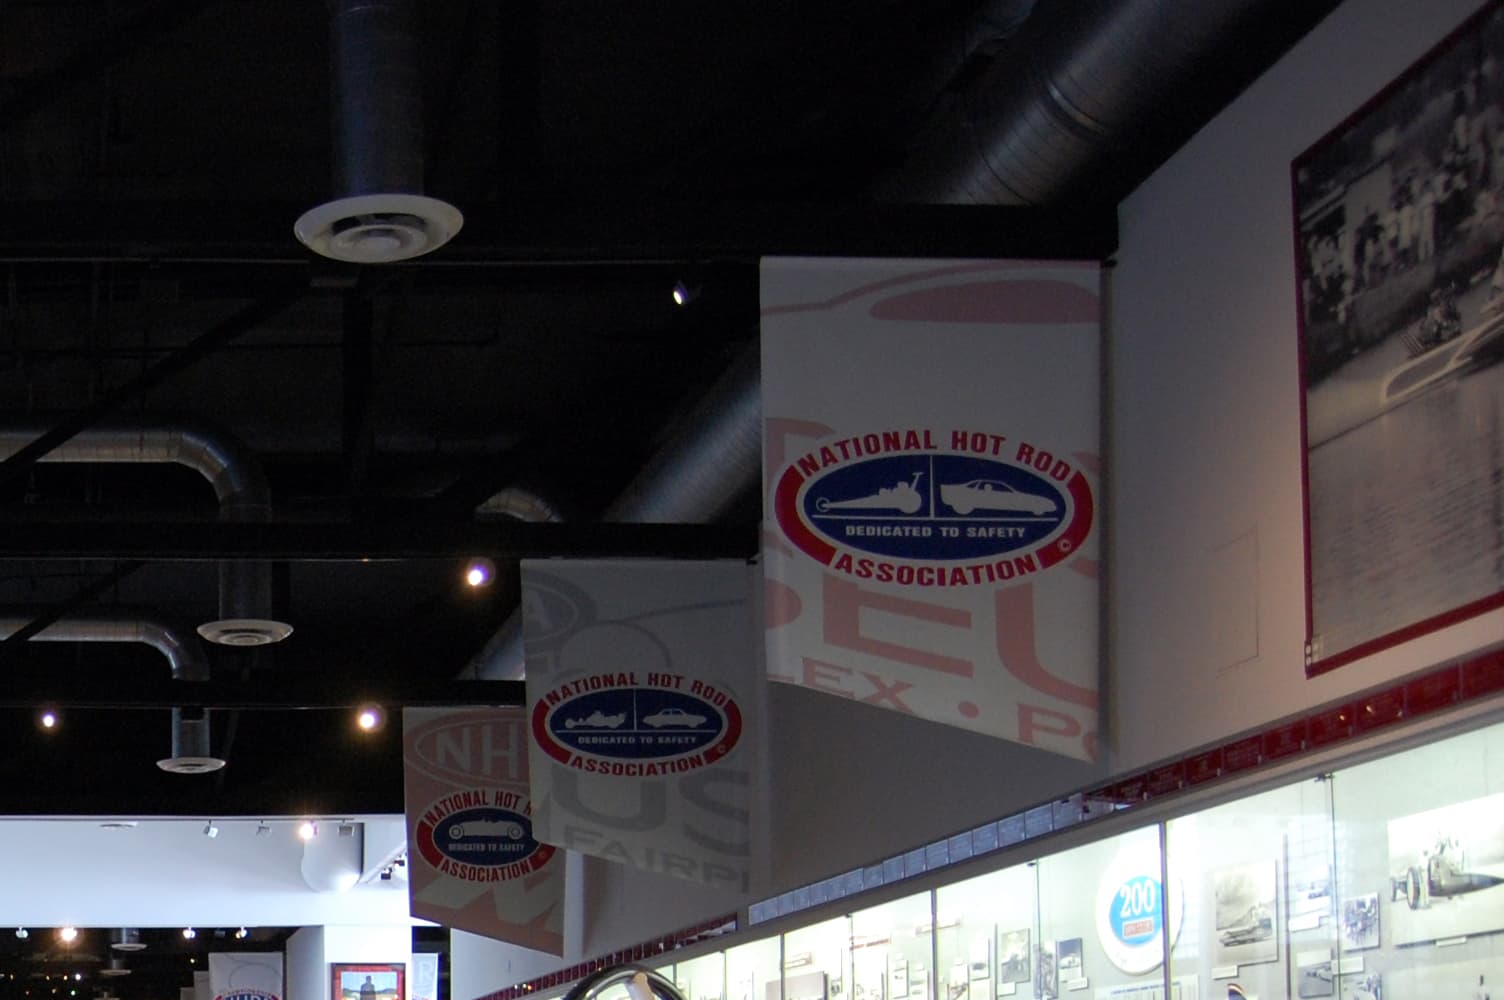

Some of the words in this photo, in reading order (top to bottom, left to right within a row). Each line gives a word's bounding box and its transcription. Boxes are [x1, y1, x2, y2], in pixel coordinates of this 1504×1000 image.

[798, 430, 938, 478] NATIONAL
[951, 430, 1006, 457] HOT
[1015, 442, 1073, 483] ROD
[845, 524, 932, 538] DEDICATED
[939, 525, 960, 539] TO
[966, 525, 1026, 540] SAFETY
[834, 554, 1037, 587] ASSOCIATION
[546, 672, 640, 705] NATIONAL
[647, 672, 684, 689] HOT
[690, 679, 734, 706] ROD
[577, 735, 636, 745] DEDICATED
[639, 736, 653, 745] TO
[657, 735, 697, 745] SAFETY
[570, 755, 704, 777] ASSOCIATION
[424, 790, 489, 824] NATIONAL
[495, 790, 522, 809] HOT
[440, 859, 532, 883] ASSOCIATION
[1119, 879, 1156, 918] 200
